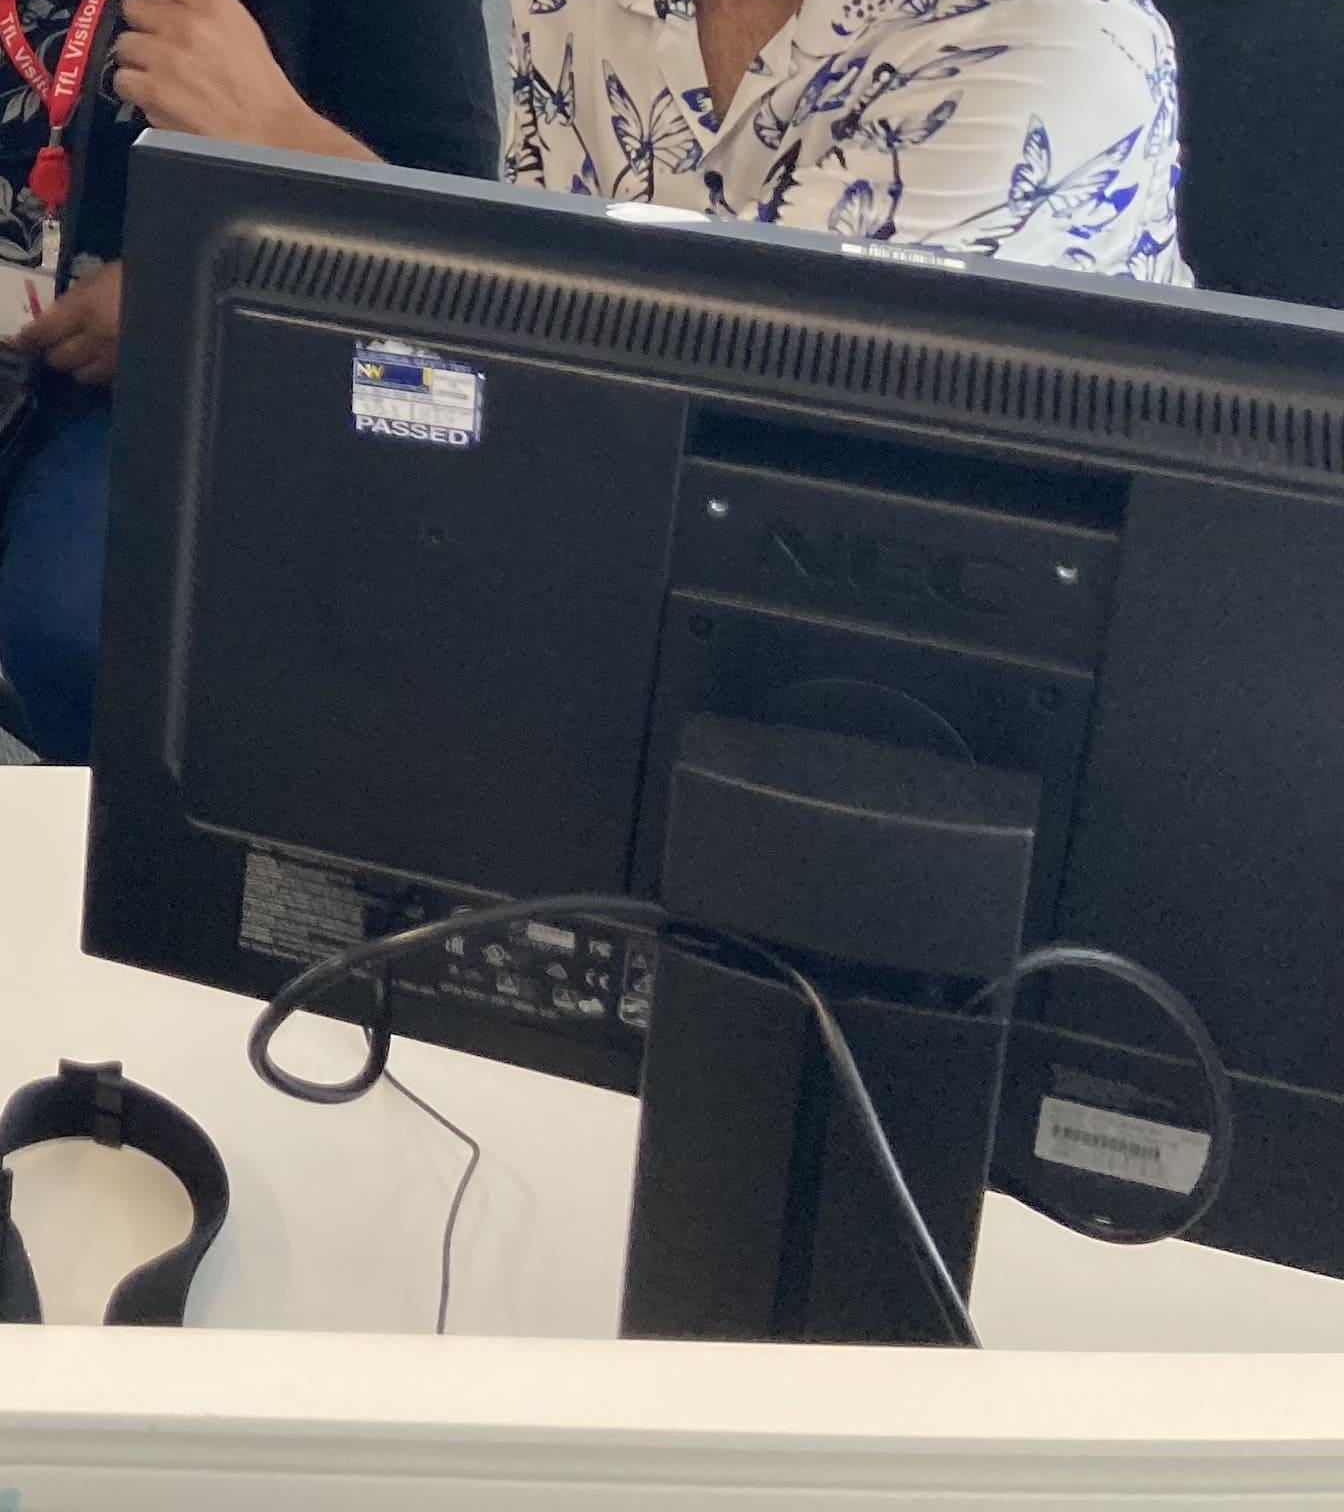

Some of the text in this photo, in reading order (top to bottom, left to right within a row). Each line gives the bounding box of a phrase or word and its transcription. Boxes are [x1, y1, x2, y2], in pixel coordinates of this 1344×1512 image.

[0, 12, 18, 48] TfL
[55, 66, 79, 97] TfL
[355, 414, 469, 446] PASSED
